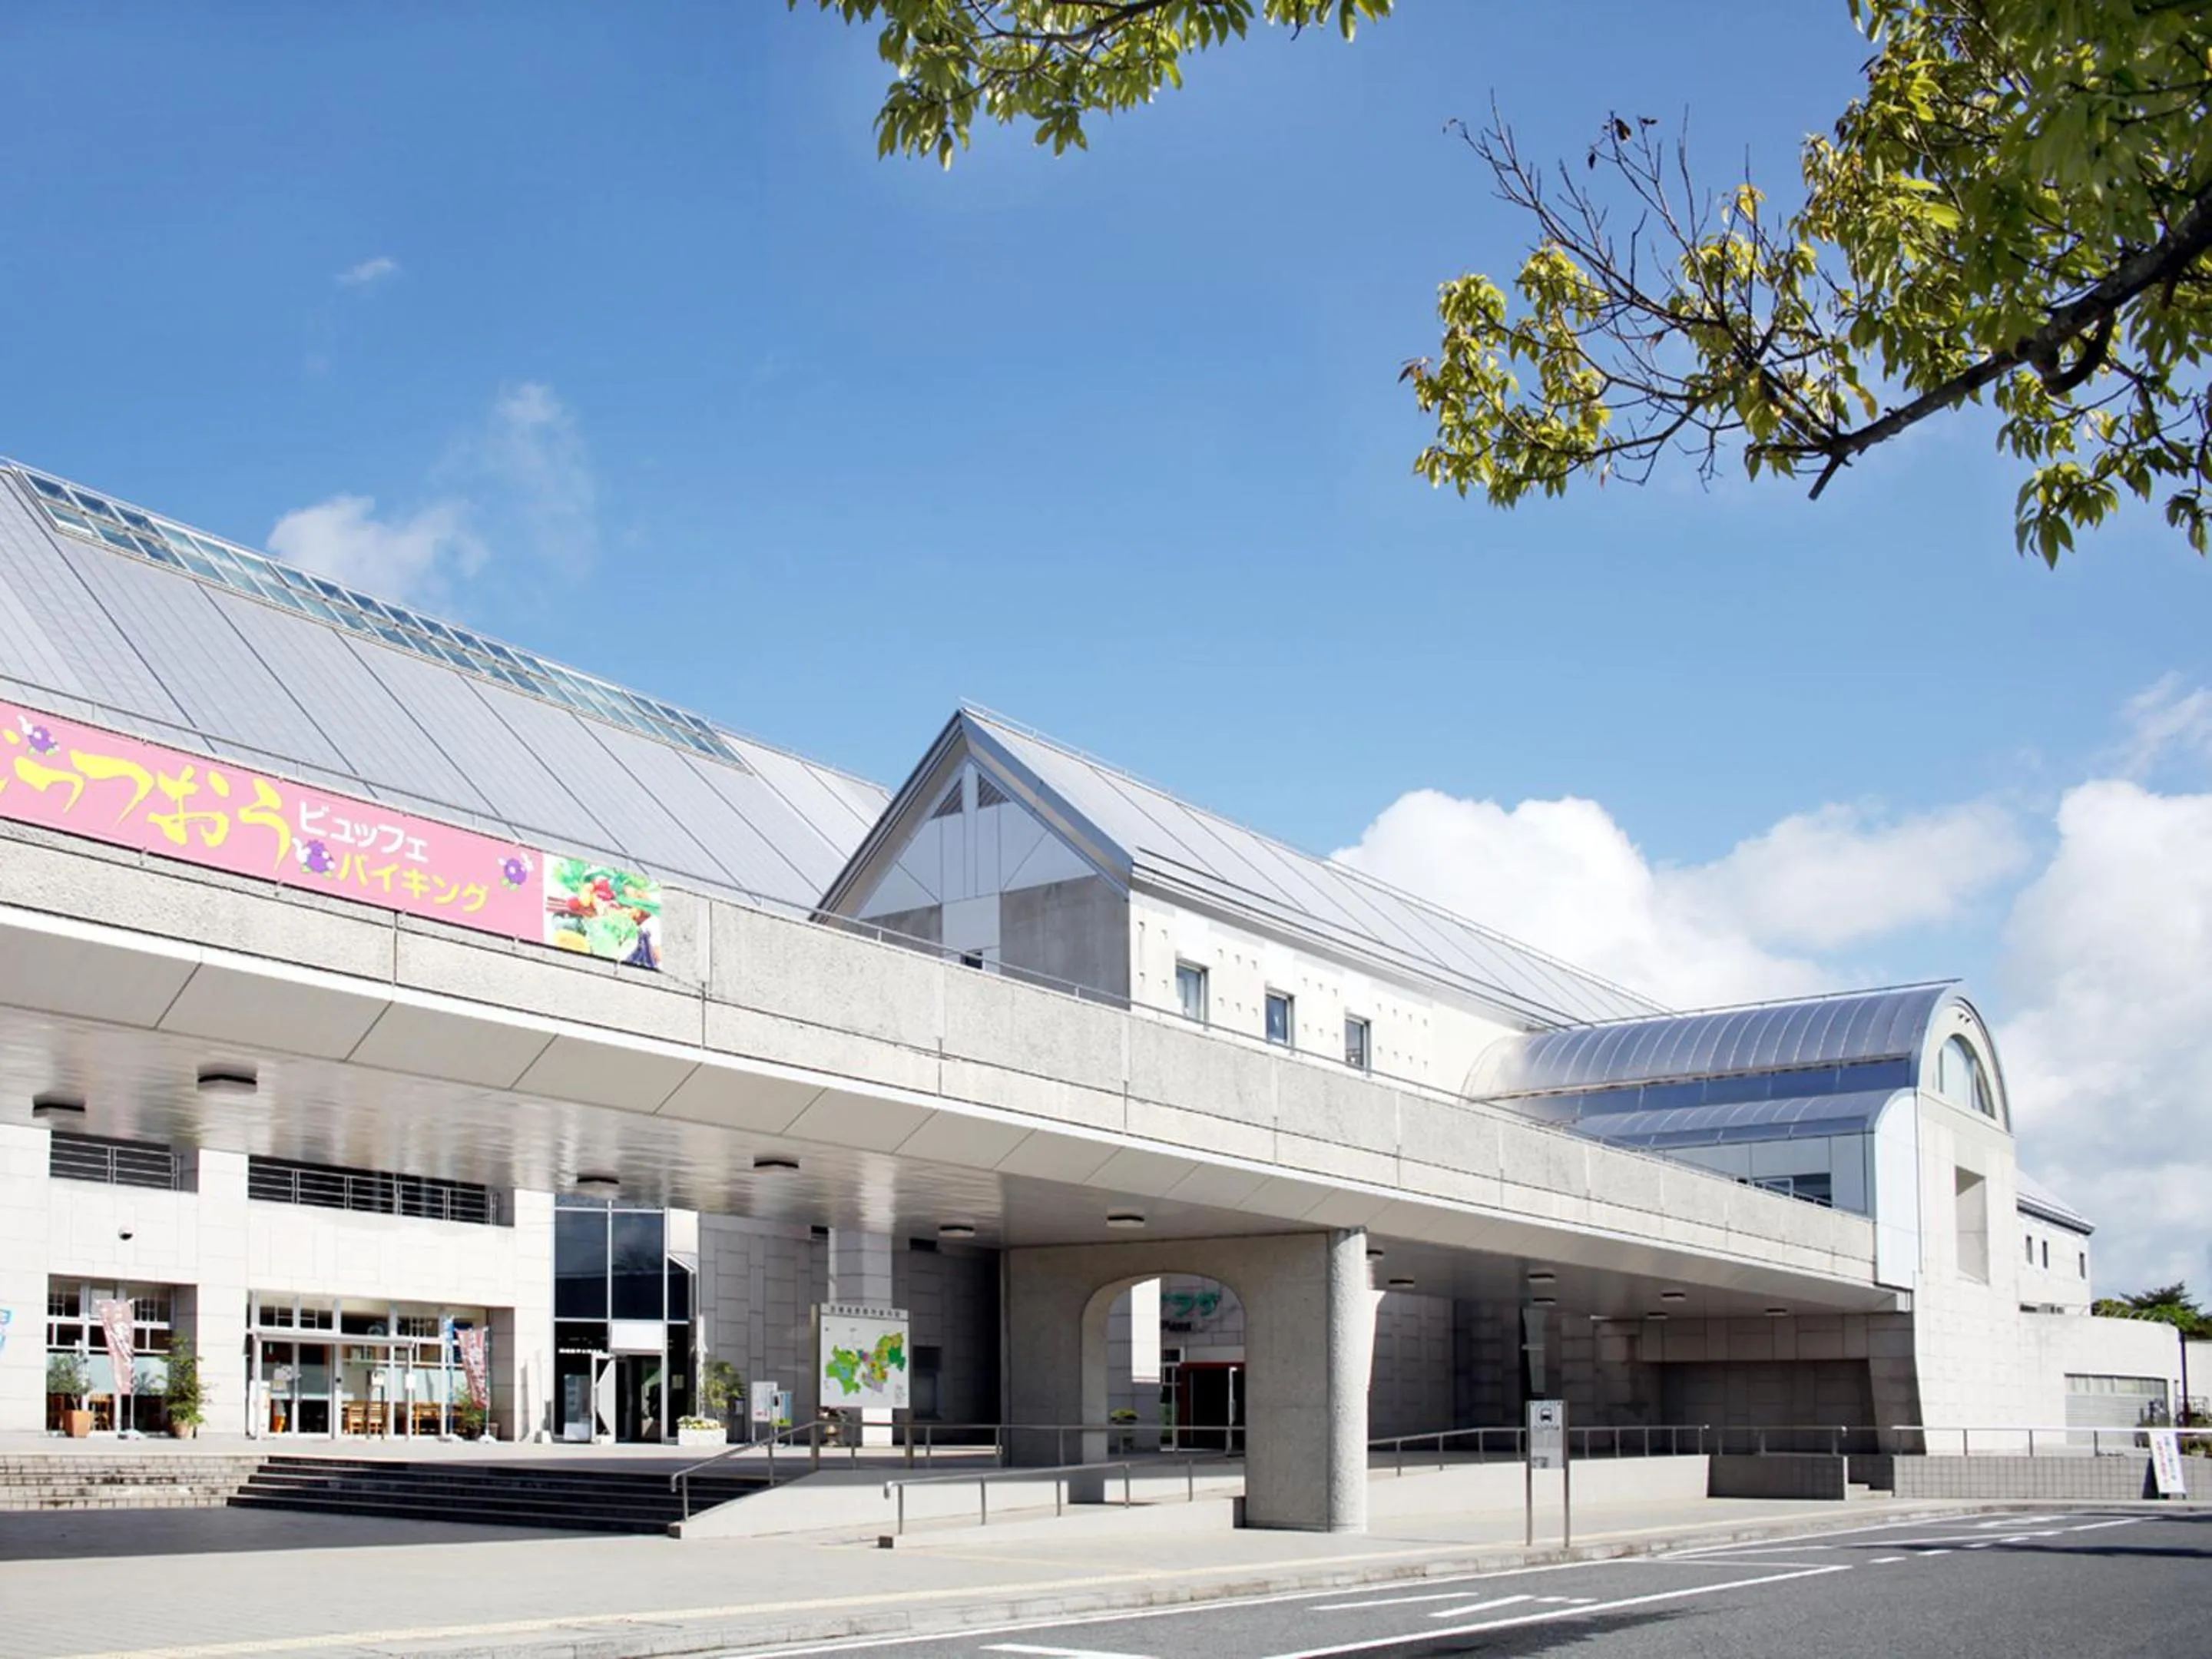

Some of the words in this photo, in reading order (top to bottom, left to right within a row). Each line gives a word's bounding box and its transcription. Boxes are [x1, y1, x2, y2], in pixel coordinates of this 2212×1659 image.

[0, 729, 292, 872] っつおう
[300, 801, 429, 863] ビュッフェ
[338, 853, 489, 912] バイキング
